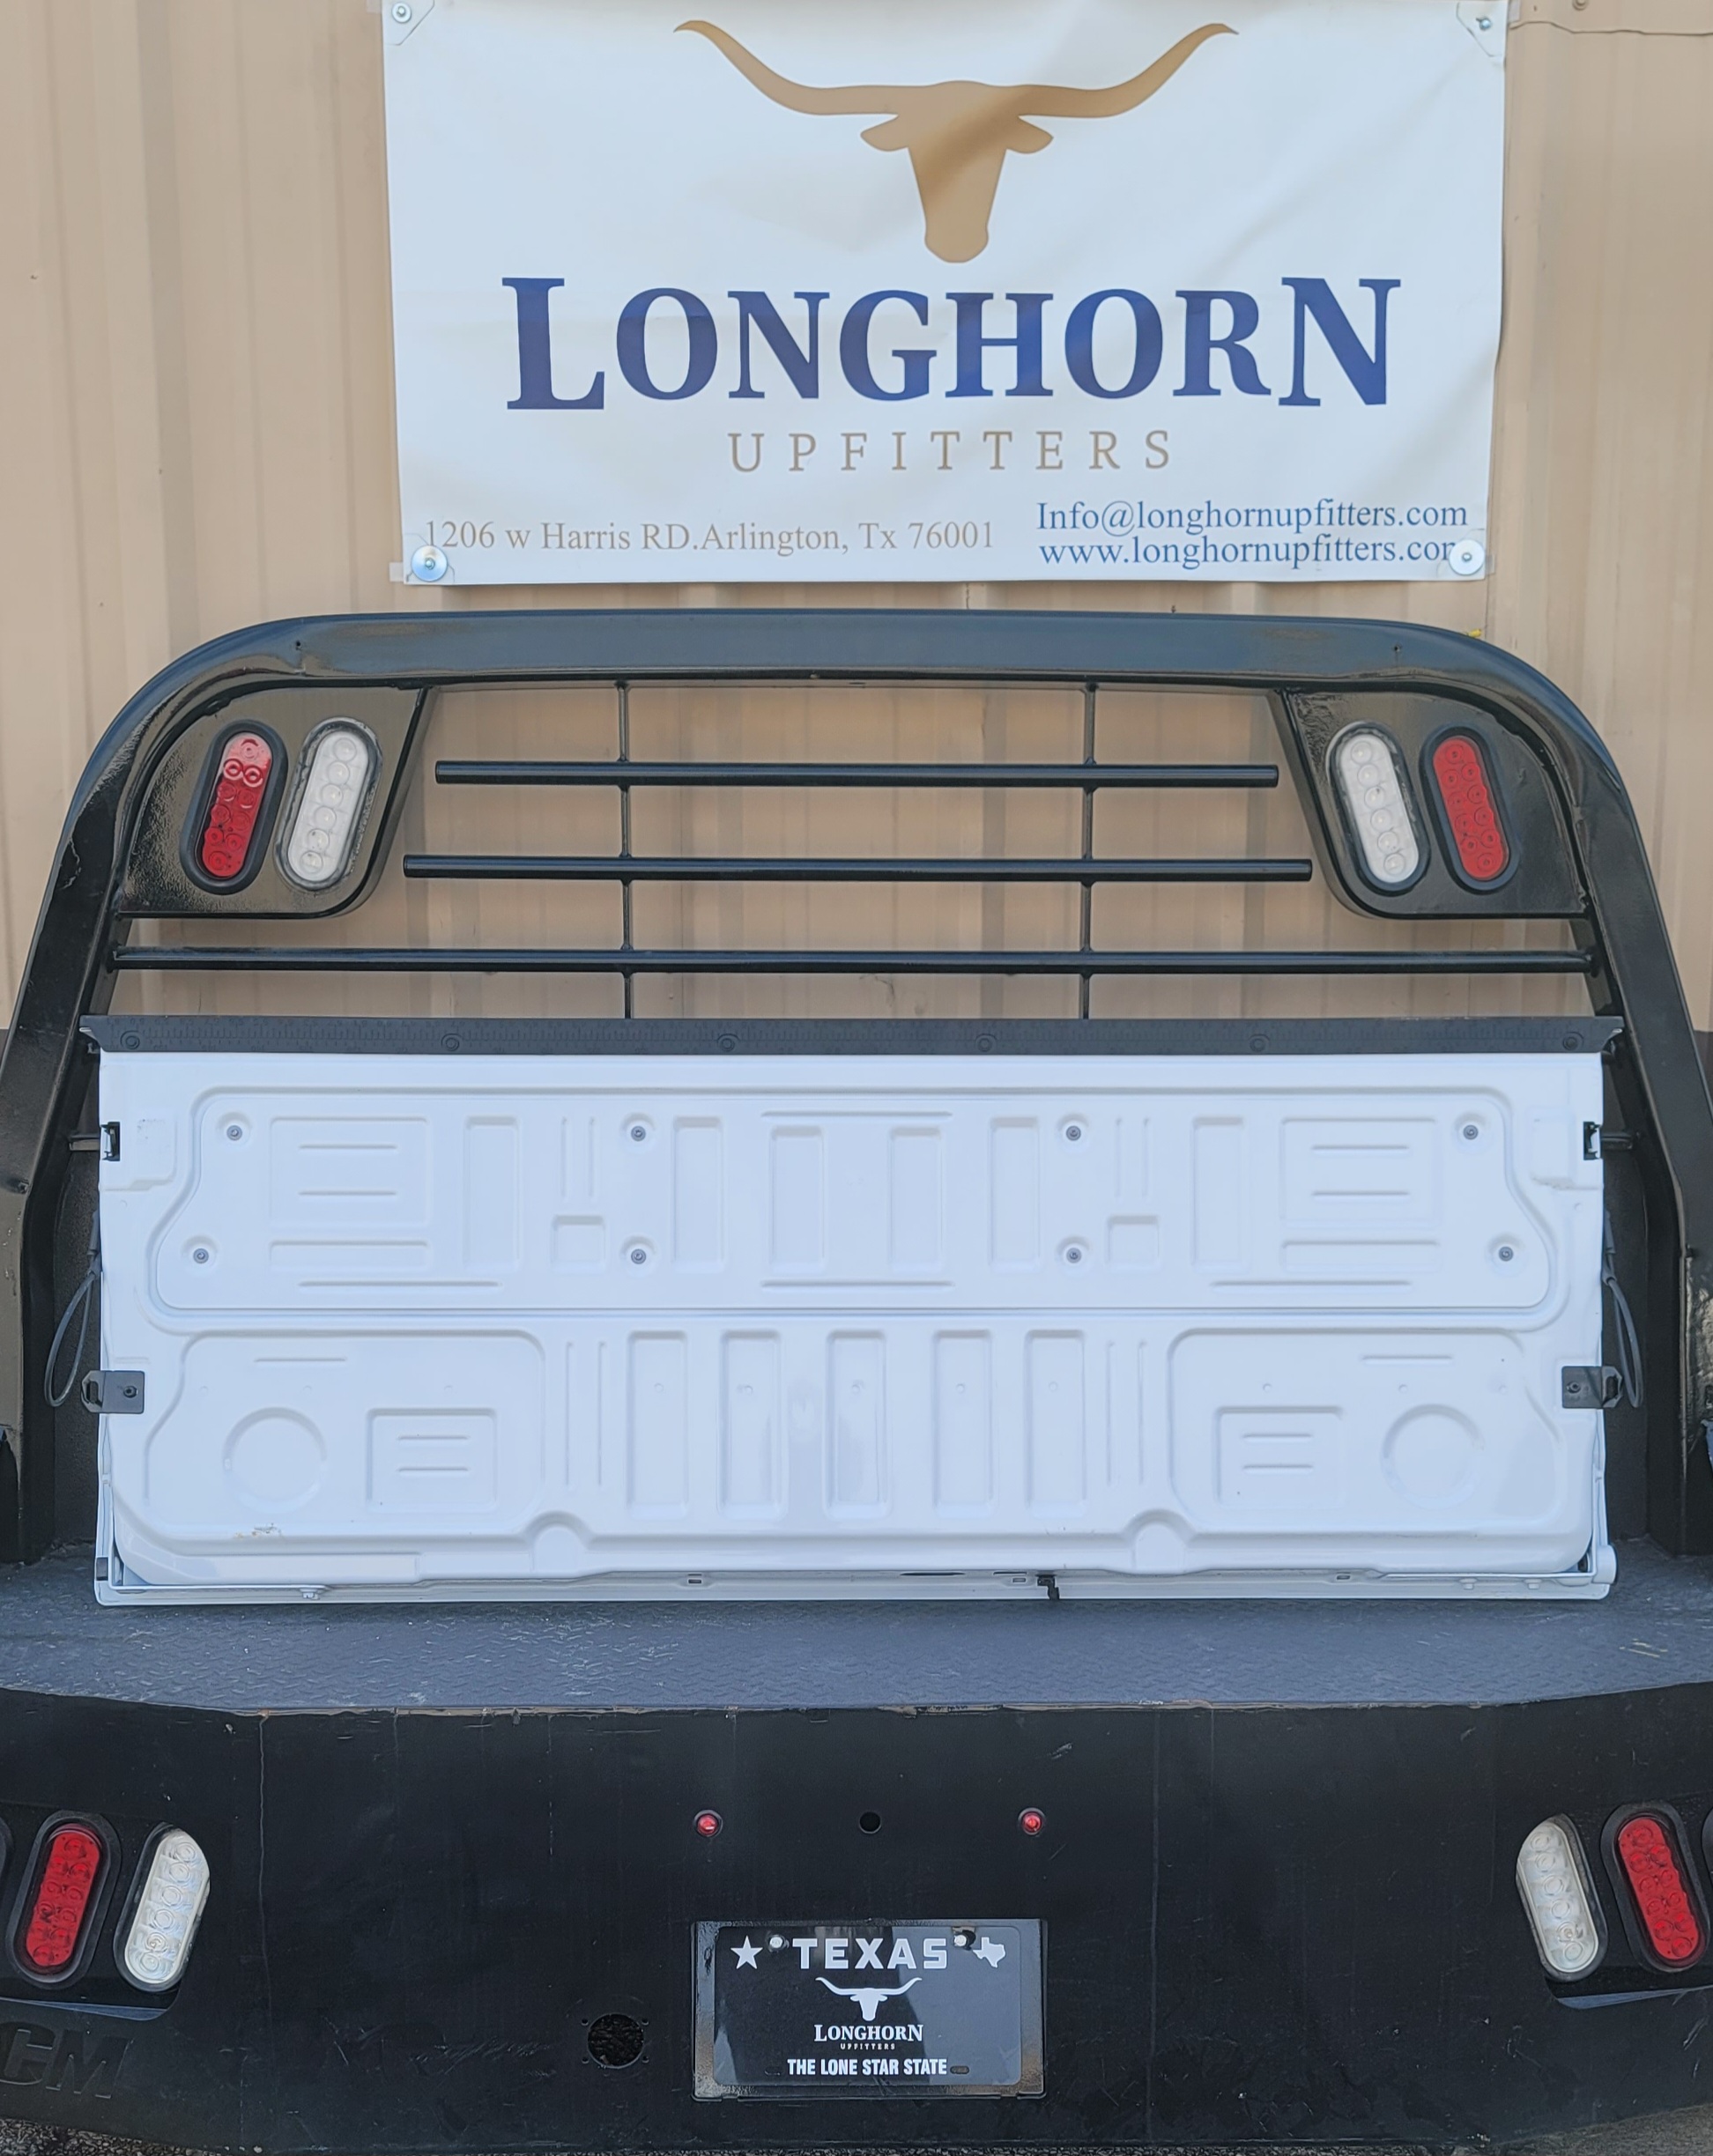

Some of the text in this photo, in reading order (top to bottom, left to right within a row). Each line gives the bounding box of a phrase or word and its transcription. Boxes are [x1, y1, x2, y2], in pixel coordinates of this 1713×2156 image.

[501, 277, 1402, 411] LONGHORN
[727, 429, 1170, 473] UPFITTERS
[1036, 498, 1468, 537] Info@longhornupfitters.com
[426, 521, 495, 549] 1206
[504, 530, 531, 549] w
[540, 522, 631, 550] Harris
[858, 522, 898, 549] Tx
[908, 521, 993, 549] 76001
[792, 1937, 947, 1969] TEXAS
[814, 2024, 923, 2042] LONGHORN
[787, 2058, 947, 2075] THE LONE STAR STATE
